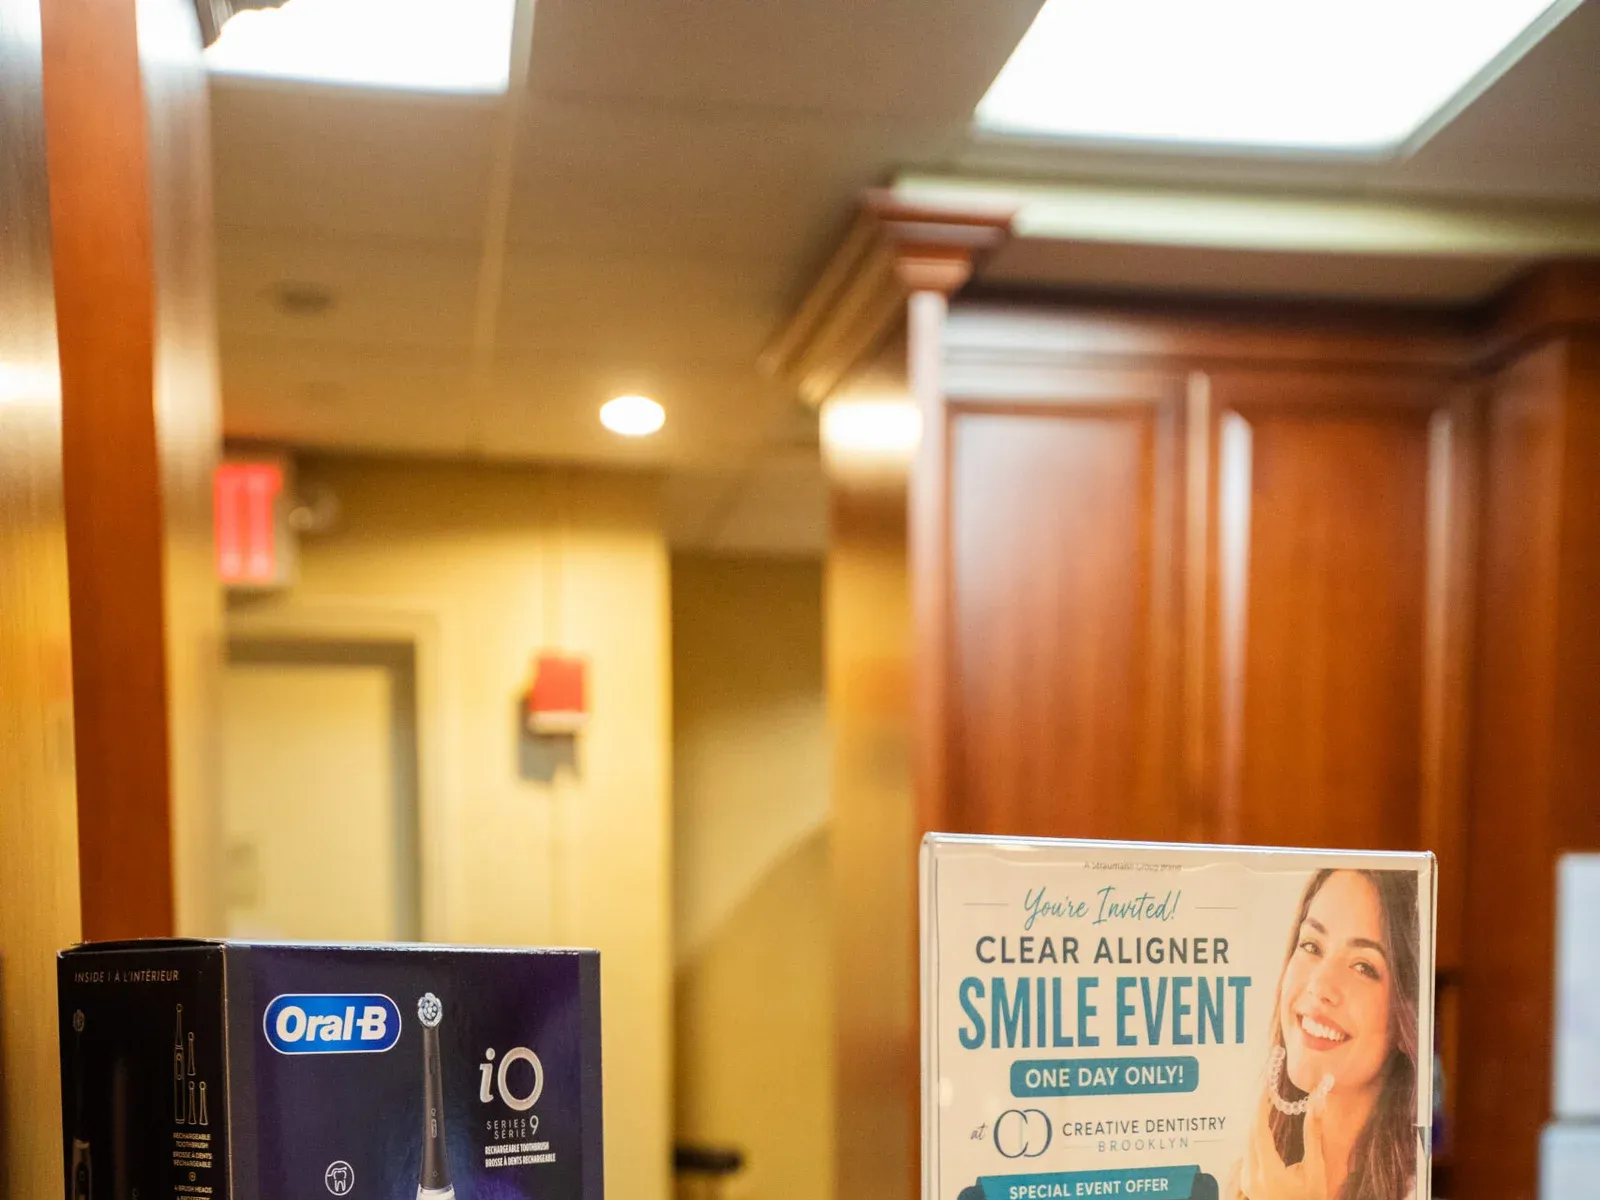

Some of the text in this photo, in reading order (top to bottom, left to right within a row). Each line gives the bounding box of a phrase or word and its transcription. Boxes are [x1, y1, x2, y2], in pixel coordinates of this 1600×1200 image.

[1024, 885, 1181, 931] You're Invited!
[976, 936, 1229, 964] CLEAR ALIGNER
[74, 971, 104, 983] INSIDE
[958, 976, 1252, 1050] SMILE EVENT
[276, 1005, 387, 1043] Oral-B
[479, 1046, 544, 1112] iO
[1025, 1065, 1184, 1089] ONE DAY ONLY!
[486, 1114, 539, 1135] SERIES 9
[970, 1122, 989, 1141] at
[1062, 1117, 1226, 1137] CREATIVE DENTISTRY
[485, 1144, 520, 1155] RECHARGEABLE
[1098, 1137, 1189, 1153] BROOKLYN
[485, 1157, 503, 1168] BROSSE
[1009, 1178, 1169, 1200] SPECIAL EVENT OFFER
